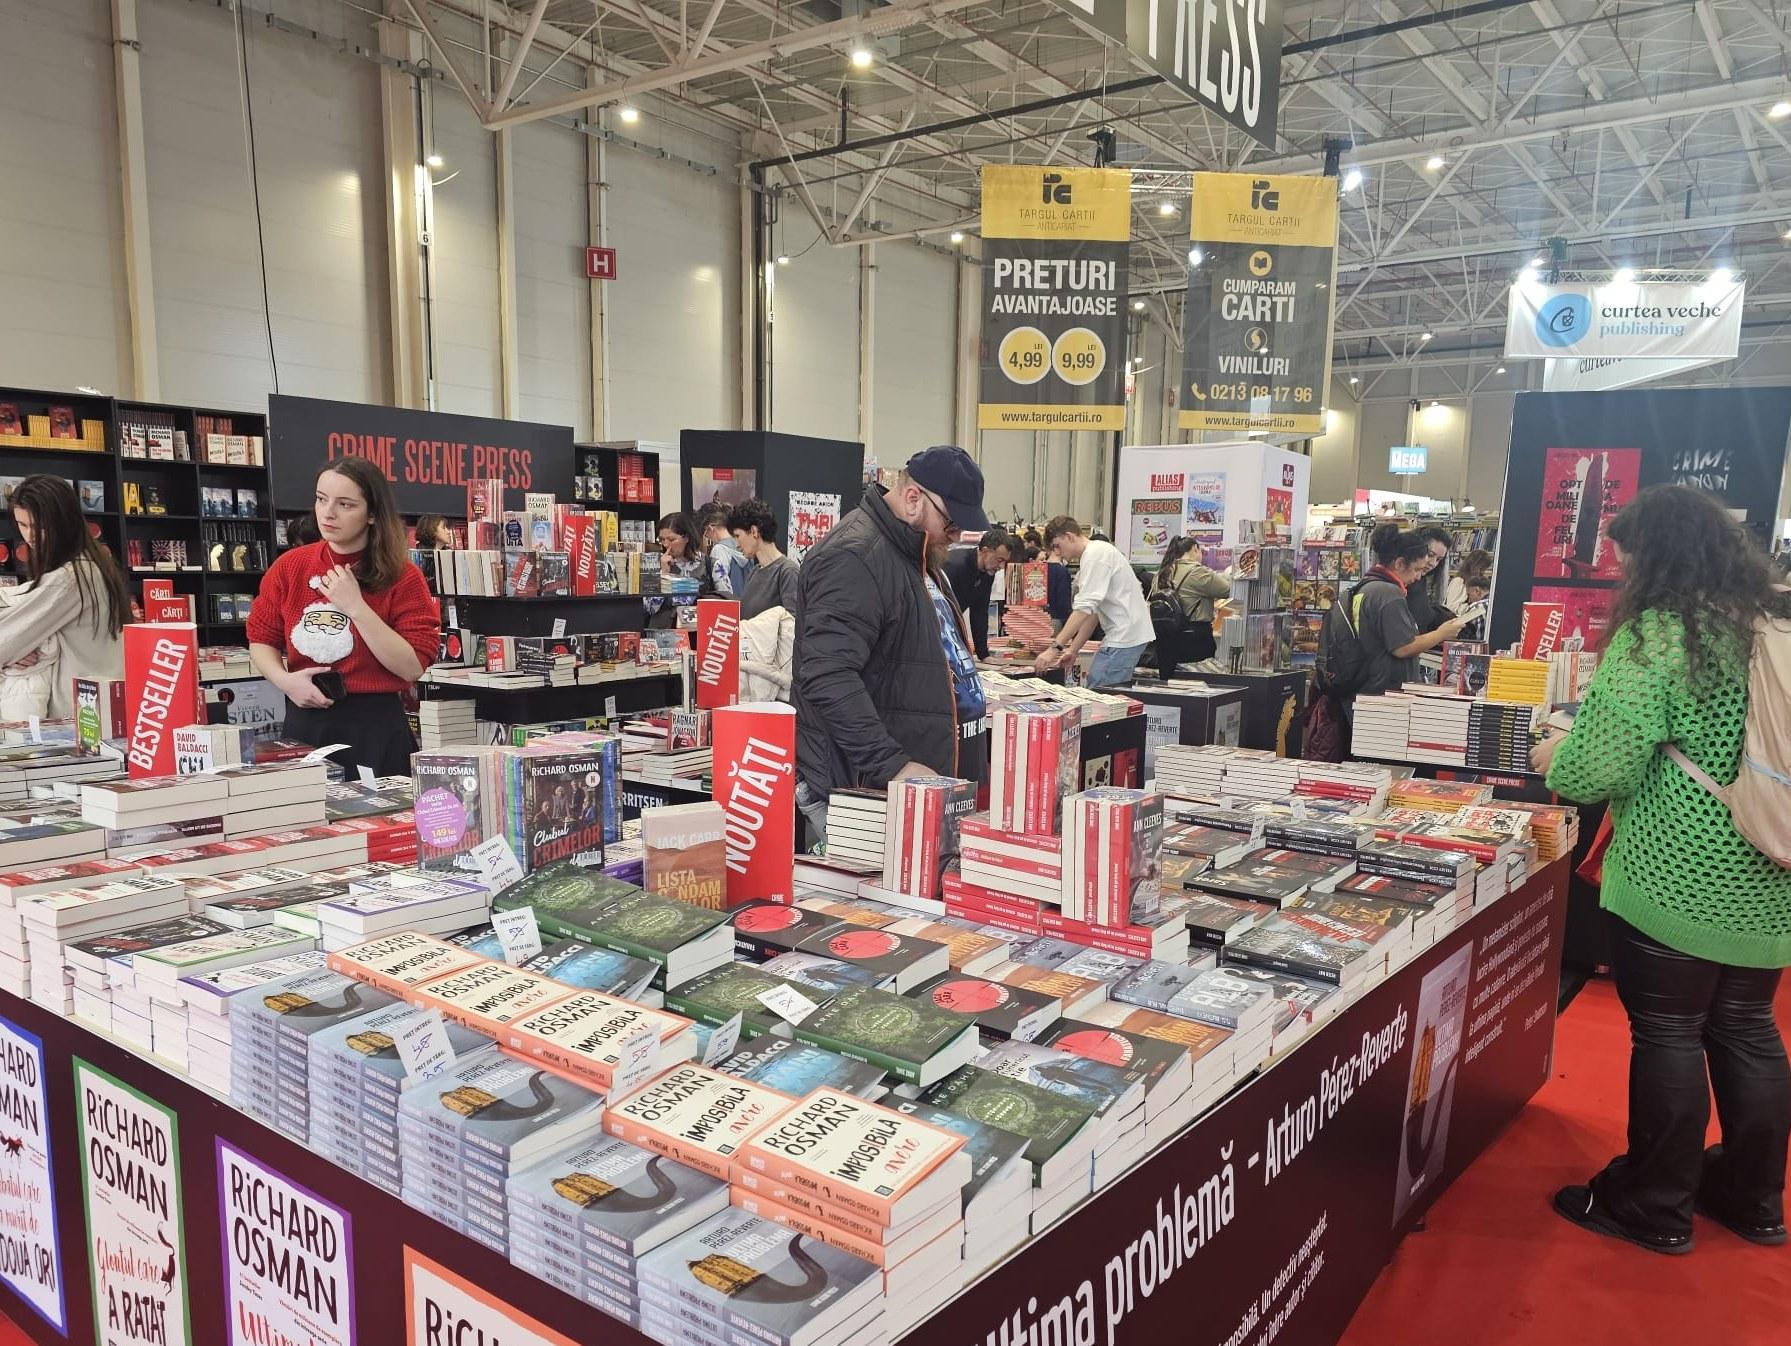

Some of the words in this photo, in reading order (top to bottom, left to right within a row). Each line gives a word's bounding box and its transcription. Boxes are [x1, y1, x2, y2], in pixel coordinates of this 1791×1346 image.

[593, 253, 609, 274] H
[994, 258, 1116, 291] PRETURI
[1223, 278, 1296, 296] CUMPARAM
[991, 295, 1117, 316] AVANTAJOASE
[1221, 294, 1296, 323] CARTI
[1601, 304, 1662, 318] curtea
[1667, 302, 1721, 318] veche
[1600, 321, 1686, 337] publishing
[1008, 351, 1043, 370] 4,99
[1061, 352, 1096, 370] 9,99
[1218, 356, 1290, 376] VINILURI
[1210, 385, 1247, 401] 0213
[1273, 387, 1290, 402] 17
[1294, 387, 1312, 403] 96
[1001, 409, 1103, 425] www.targulcartii.ro
[404, 439, 469, 486] SCENE
[472, 446, 533, 490] PRESS
[1560, 480, 1583, 489] OPT
[1134, 502, 1181, 513] REBUS
[1562, 514, 1577, 523] DE
[1554, 525, 1574, 535] FEL
[128, 638, 188, 771] BESTSELLER
[176, 733, 196, 742] DAVID
[962, 720, 977, 739] THE
[447, 766, 476, 776] OSMAN
[568, 762, 599, 773] OSMAN
[533, 825, 569, 847] Clubul
[657, 870, 696, 889] LISTA
[357, 938, 428, 962] OSMAN
[441, 970, 514, 999] OSMAN
[539, 1000, 612, 1036] OSMAN
[641, 1075, 715, 1121] OSMAN
[783, 1104, 860, 1156] OSMAN
[90, 1137, 169, 1222] OSMAN
[1104, 1139, 1236, 1346] problemă
[1264, 1095, 1317, 1187] Arturo
[1319, 1002, 1408, 1130] Pérez-Reverte
[34, 1248, 56, 1293] ORI
[234, 1219, 338, 1325] OSMAN
[1261, 1289, 1272, 1315] Un
[1272, 1254, 1298, 1301] detectiv
[108, 1284, 121, 1332] A
[1284, 1284, 1301, 1321] autor
